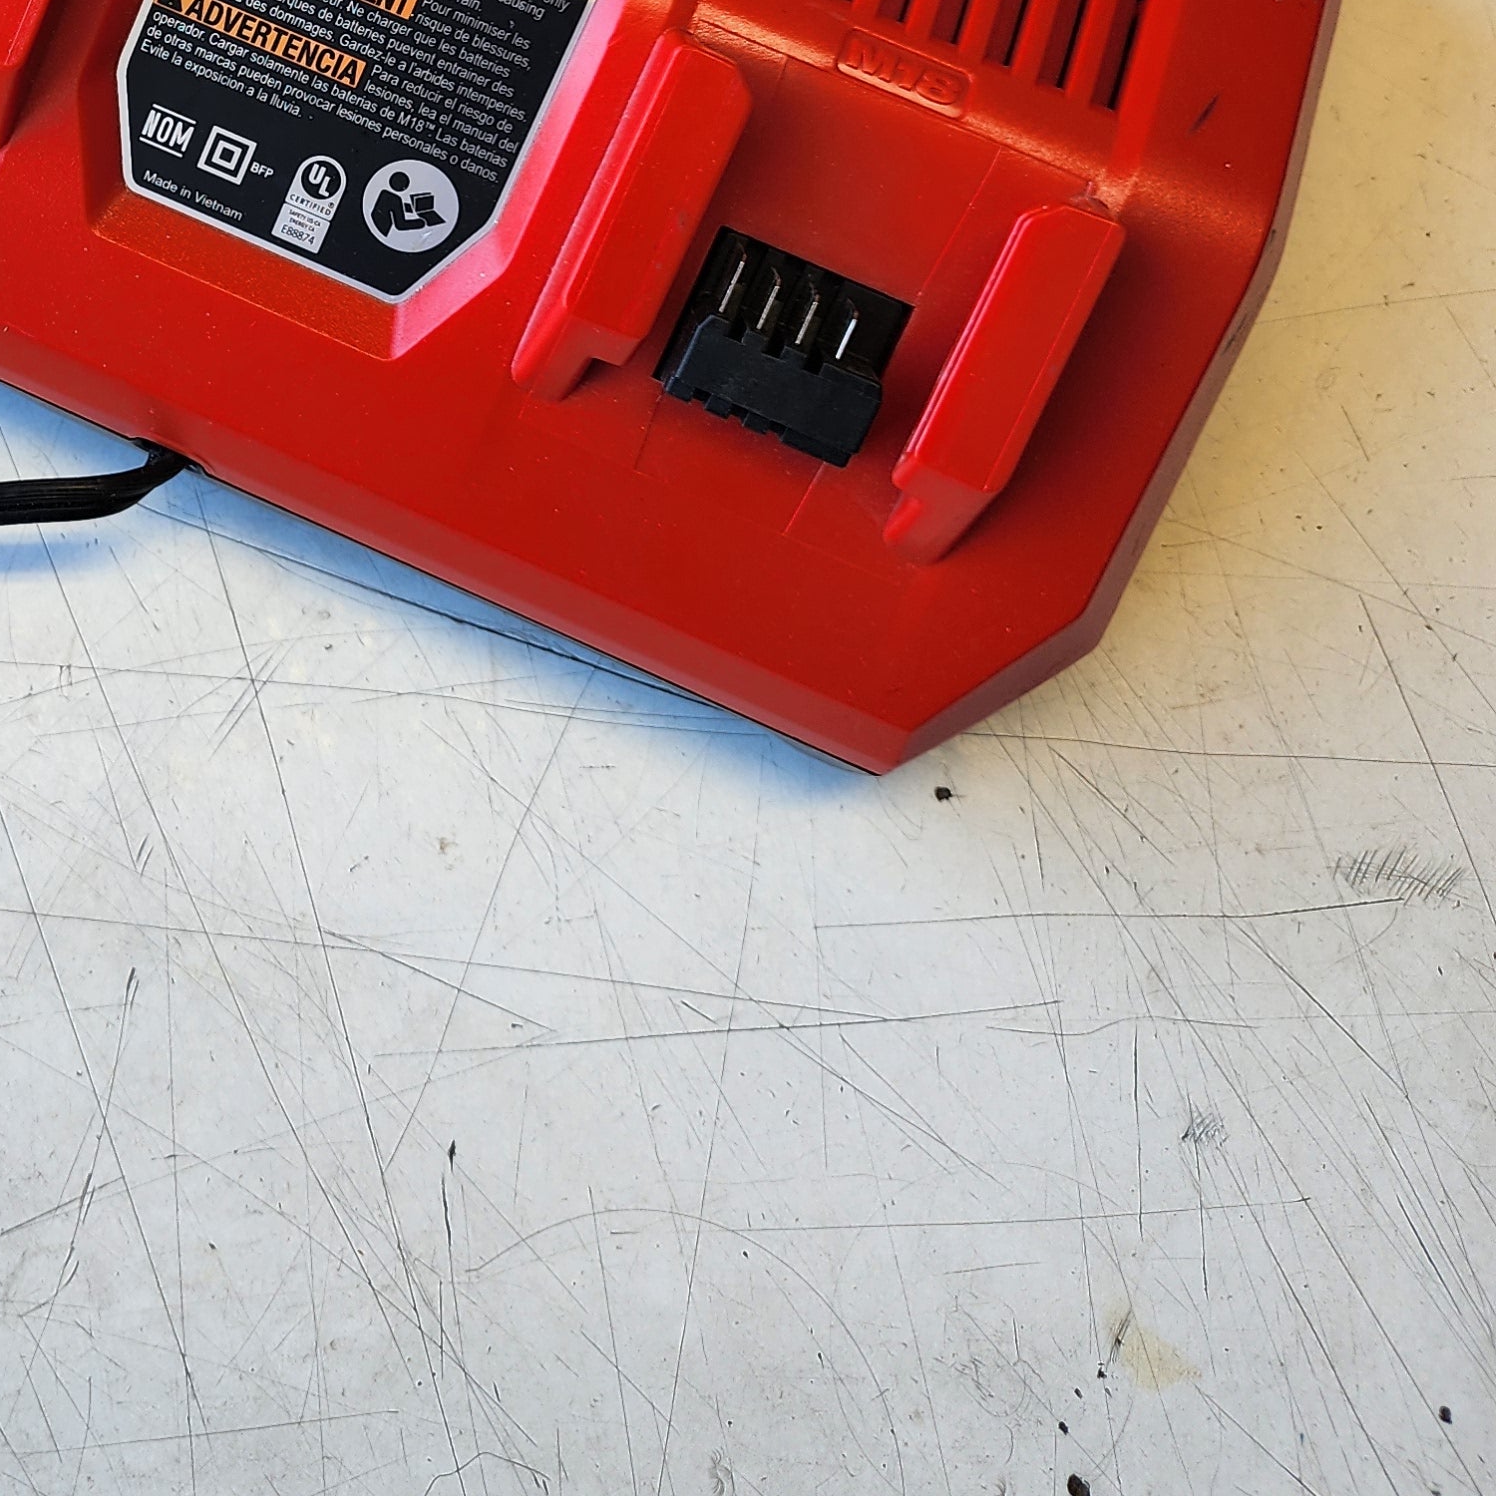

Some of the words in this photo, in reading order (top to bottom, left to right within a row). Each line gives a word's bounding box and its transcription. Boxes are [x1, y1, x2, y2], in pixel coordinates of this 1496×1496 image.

[317, 7, 334, 23] de
[334, 12, 386, 45] batteries
[385, 38, 436, 66] puevent
[436, 58, 492, 88] entrainer
[491, 80, 515, 98] des
[346, 0, 365, 18] Ne
[366, 10, 414, 37] charger
[413, 31, 437, 47] que
[437, 38, 458, 56] les
[458, 46, 511, 78] batteries
[414, 12, 453, 36] risque
[453, 28, 470, 43] de
[471, 33, 531, 71] blessures,
[452, 10, 512, 41] minimiser
[511, 32, 531, 50] les
[140, 38, 170, 61] Evite
[170, 51, 183, 66] la
[184, 60, 245, 93] exposicion
[255, 87, 269, 103] la
[269, 93, 302, 118] lluvia.
[152, 11, 206, 41] operador.
[208, 32, 250, 58] Cargar
[249, 52, 310, 85] solamente
[310, 74, 330, 93] las
[330, 83, 378, 113] baterias
[379, 105, 396, 121] de
[435, 127, 459, 147] Las
[459, 137, 508, 168] baterias
[268, 5, 335, 42] dommages.
[339, 33, 397, 67] Gardez-le
[407, 61, 456, 92] l'arbides
[455, 81, 527, 123] intemperies.
[844, 38, 960, 105] M18
[141, 109, 195, 153] NOM
[146, 24, 163, 40] de
[163, 33, 193, 53] otras
[193, 46, 238, 72] marcas
[236, 65, 282, 91] pueden
[282, 84, 336, 112] provocar
[335, 103, 383, 133] lesiones
[381, 126, 449, 161] personales
[460, 157, 499, 184] danos.
[363, 79, 415, 113] lesiones,
[417, 101, 438, 120] lea
[438, 113, 453, 126] el
[451, 119, 499, 145] manual
[498, 137, 520, 154] del
[370, 64, 400, 86] Para
[400, 80, 444, 104] reducir
[444, 97, 458, 110] el
[457, 102, 495, 126] riesgo
[496, 118, 513, 134] de
[143, 169, 178, 193] Made
[179, 185, 192, 199] in
[195, 191, 243, 221] Vietnam
[249, 161, 274, 178] BFP
[308, 163, 331, 198] UL
[280, 223, 316, 246] E88874
[289, 193, 332, 216] CERTIFIED
